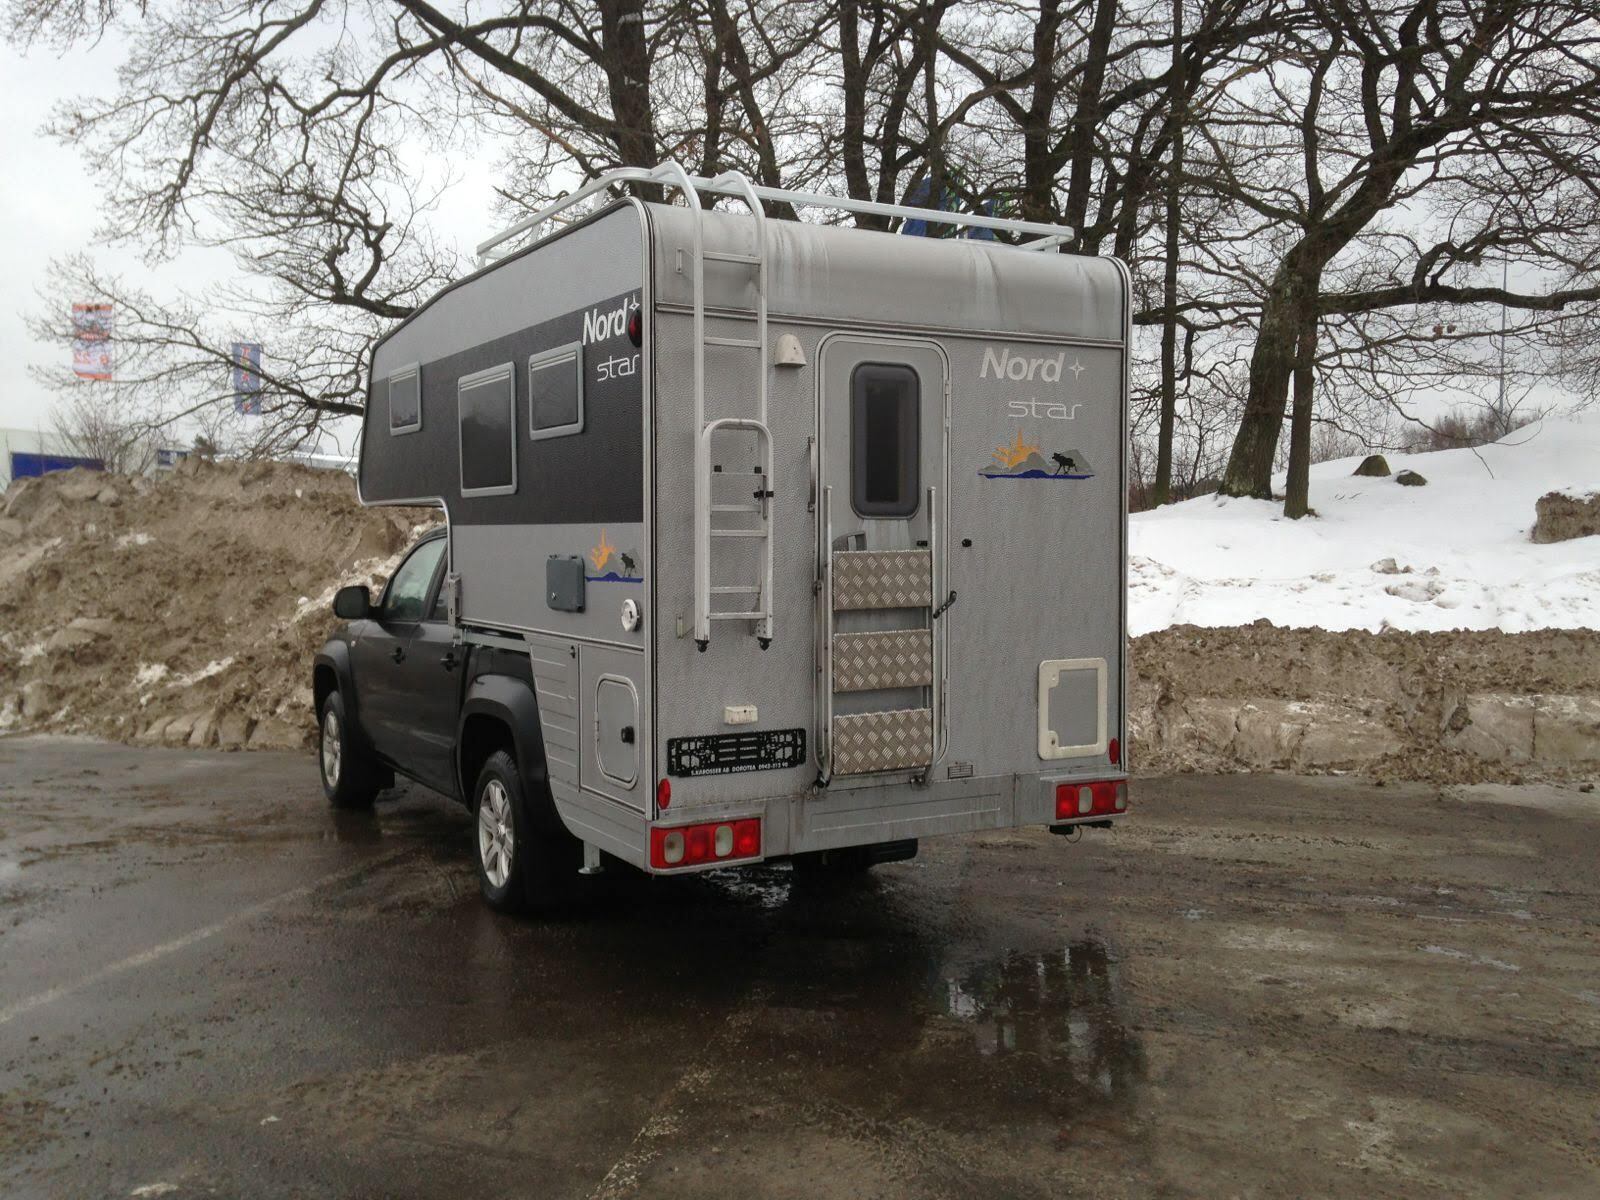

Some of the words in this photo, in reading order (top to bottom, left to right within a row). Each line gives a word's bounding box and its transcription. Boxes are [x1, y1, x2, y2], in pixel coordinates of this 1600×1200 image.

[583, 297, 628, 345] Nord
[597, 354, 640, 382] star
[979, 347, 1065, 382] Nord
[1008, 397, 1082, 420] star
[731, 764, 756, 773] DOROTEA
